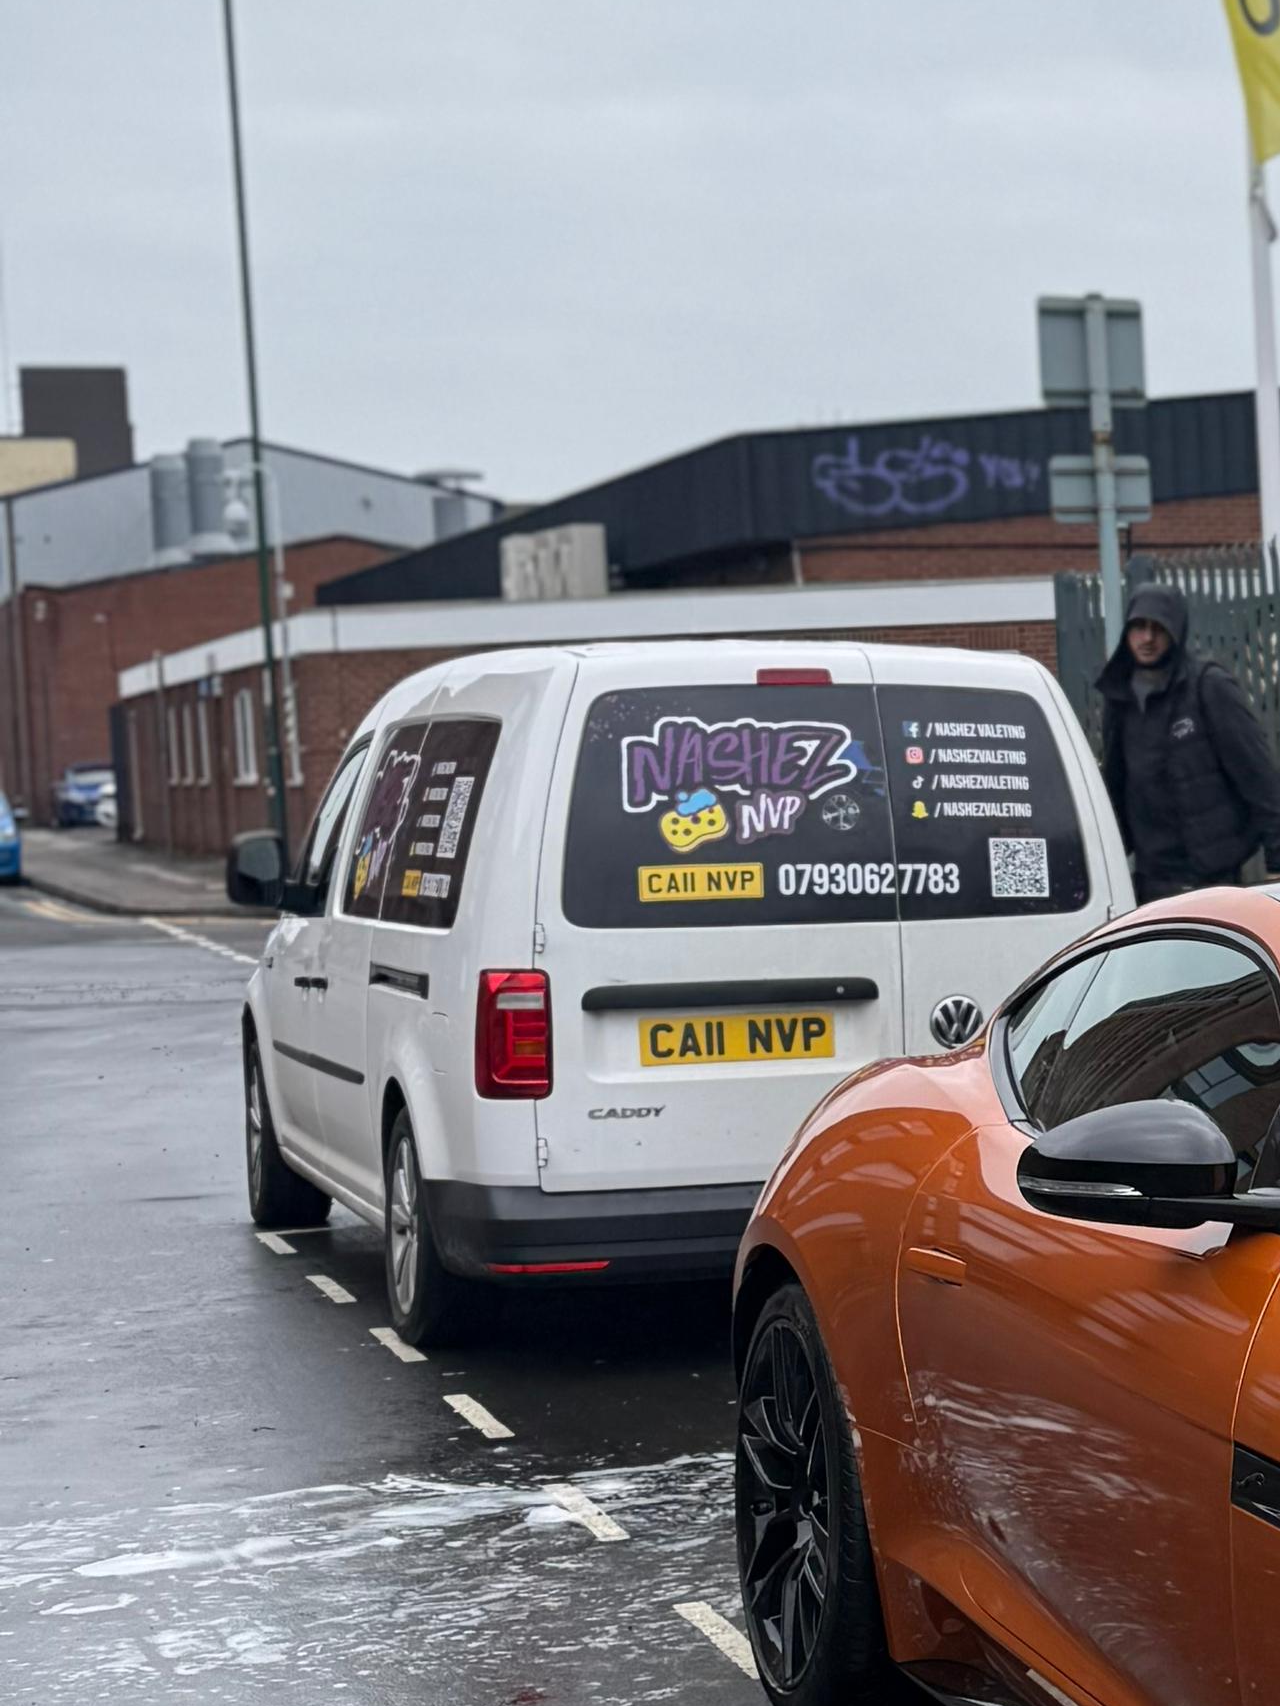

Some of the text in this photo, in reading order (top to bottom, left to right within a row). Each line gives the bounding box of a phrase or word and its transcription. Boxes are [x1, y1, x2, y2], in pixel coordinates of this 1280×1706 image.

[934, 722, 977, 737] NASHEZ
[977, 723, 1026, 739] VALETING
[628, 723, 850, 807] NASHEZ
[937, 749, 1027, 765] NASHEZVALETING
[940, 775, 1029, 790] NASHEZVALETING
[741, 793, 801, 839] NVP
[943, 802, 1032, 818] NASHEZVALETING
[707, 871, 754, 892] NVP
[778, 863, 960, 895] 07930627783
[748, 1017, 826, 1053] NVP
[588, 1105, 666, 1120] CADDY
